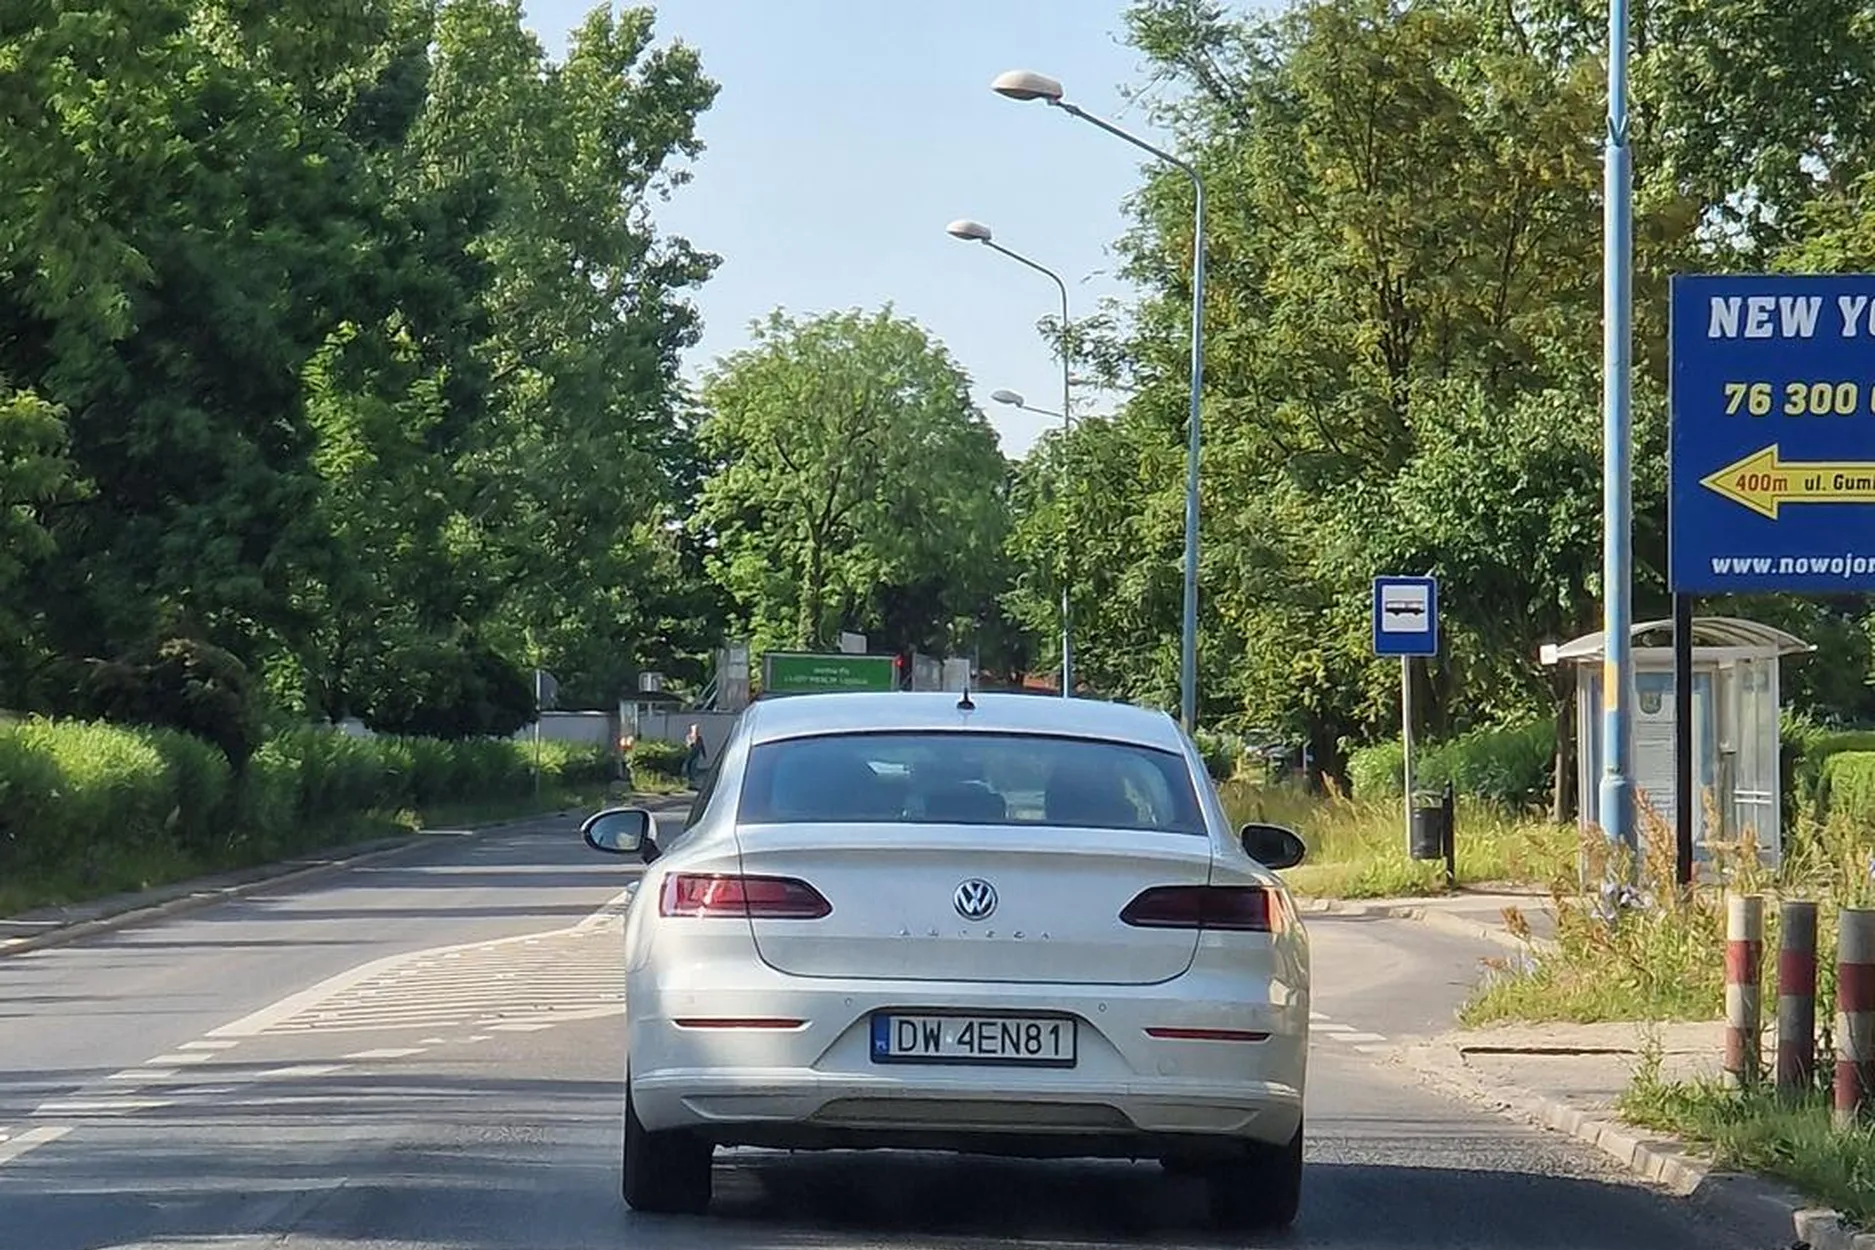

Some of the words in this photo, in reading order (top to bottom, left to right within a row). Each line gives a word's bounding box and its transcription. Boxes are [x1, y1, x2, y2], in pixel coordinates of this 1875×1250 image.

[1708, 296, 1823, 338] NEW
[1838, 296, 1875, 338] Y
[1724, 383, 1773, 416] 76
[1784, 383, 1859, 416] 300
[1735, 473, 1788, 493] 400m
[1804, 474, 1827, 492] ul.
[897, 1019, 942, 1053] DW
[957, 1021, 1062, 1056] 4EN81
